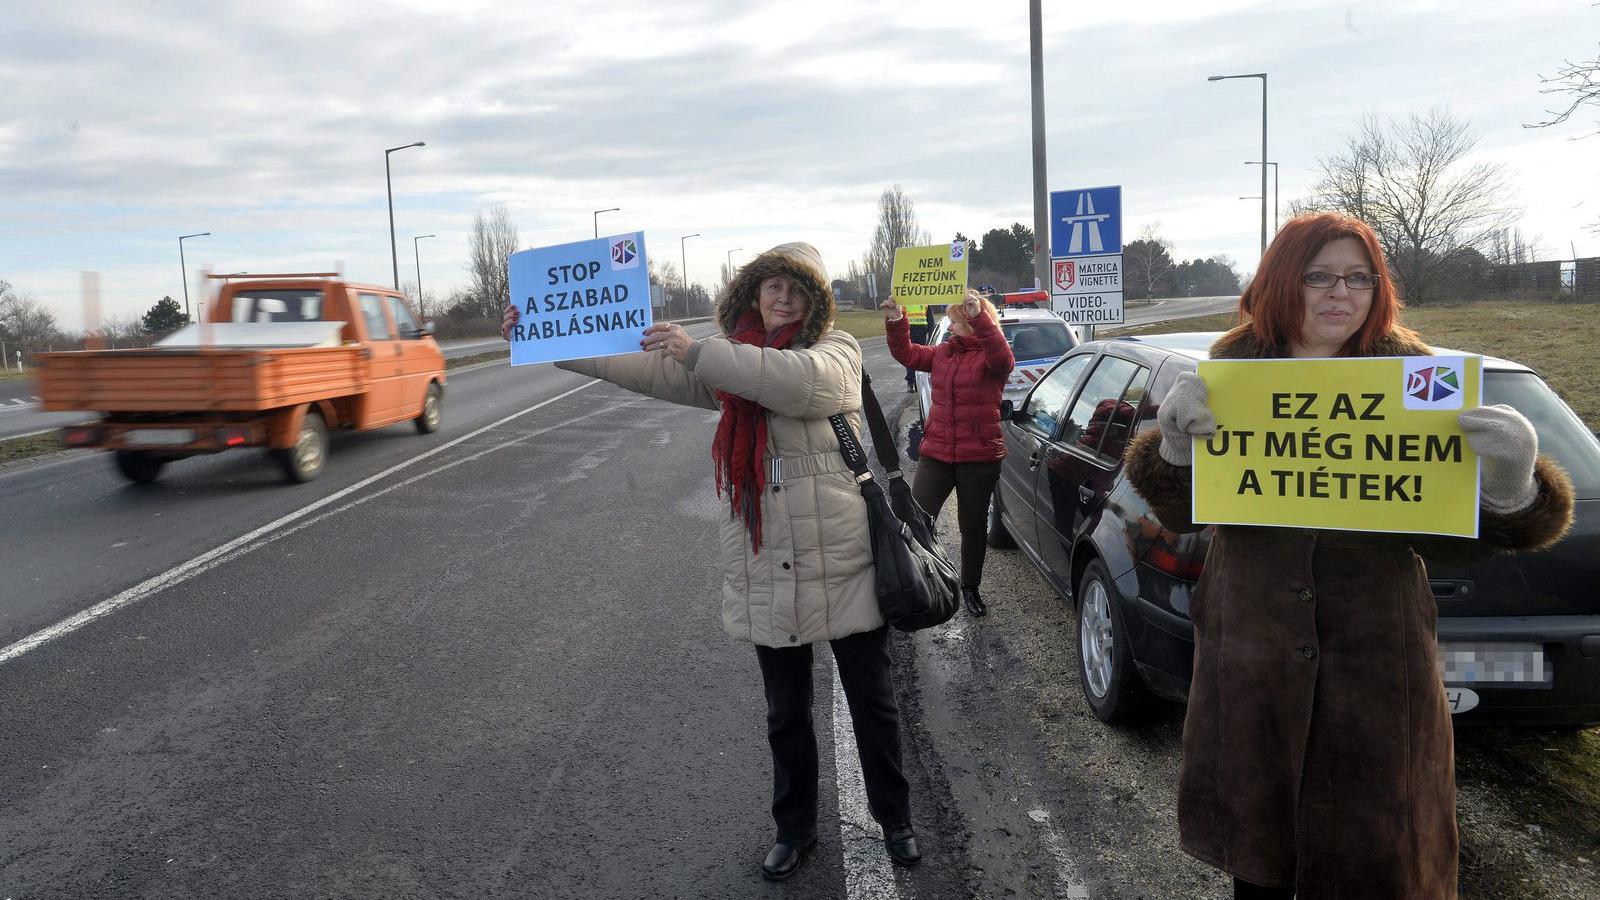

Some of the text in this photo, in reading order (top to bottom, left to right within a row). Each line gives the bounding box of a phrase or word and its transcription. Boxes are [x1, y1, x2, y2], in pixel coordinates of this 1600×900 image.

[547, 260, 601, 286] STOP
[902, 269, 957, 282] FIZETÜNK
[918, 257, 943, 268] NEM
[1079, 262, 1118, 274] MATRICA
[894, 283, 963, 297] TÉVÚTDÍJAT!
[1079, 275, 1119, 286] VIGNETTE
[525, 284, 629, 315] A SZABAD
[1068, 295, 1107, 309] VIDEO-
[514, 308, 646, 342] RABLÁSNAK!
[1407, 365, 1460, 402] DK
[1272, 392, 1386, 421] EZ AZ
[1206, 424, 1462, 463] ÚT MÉG NEM
[1236, 466, 1423, 503] A TIÉTEK!
